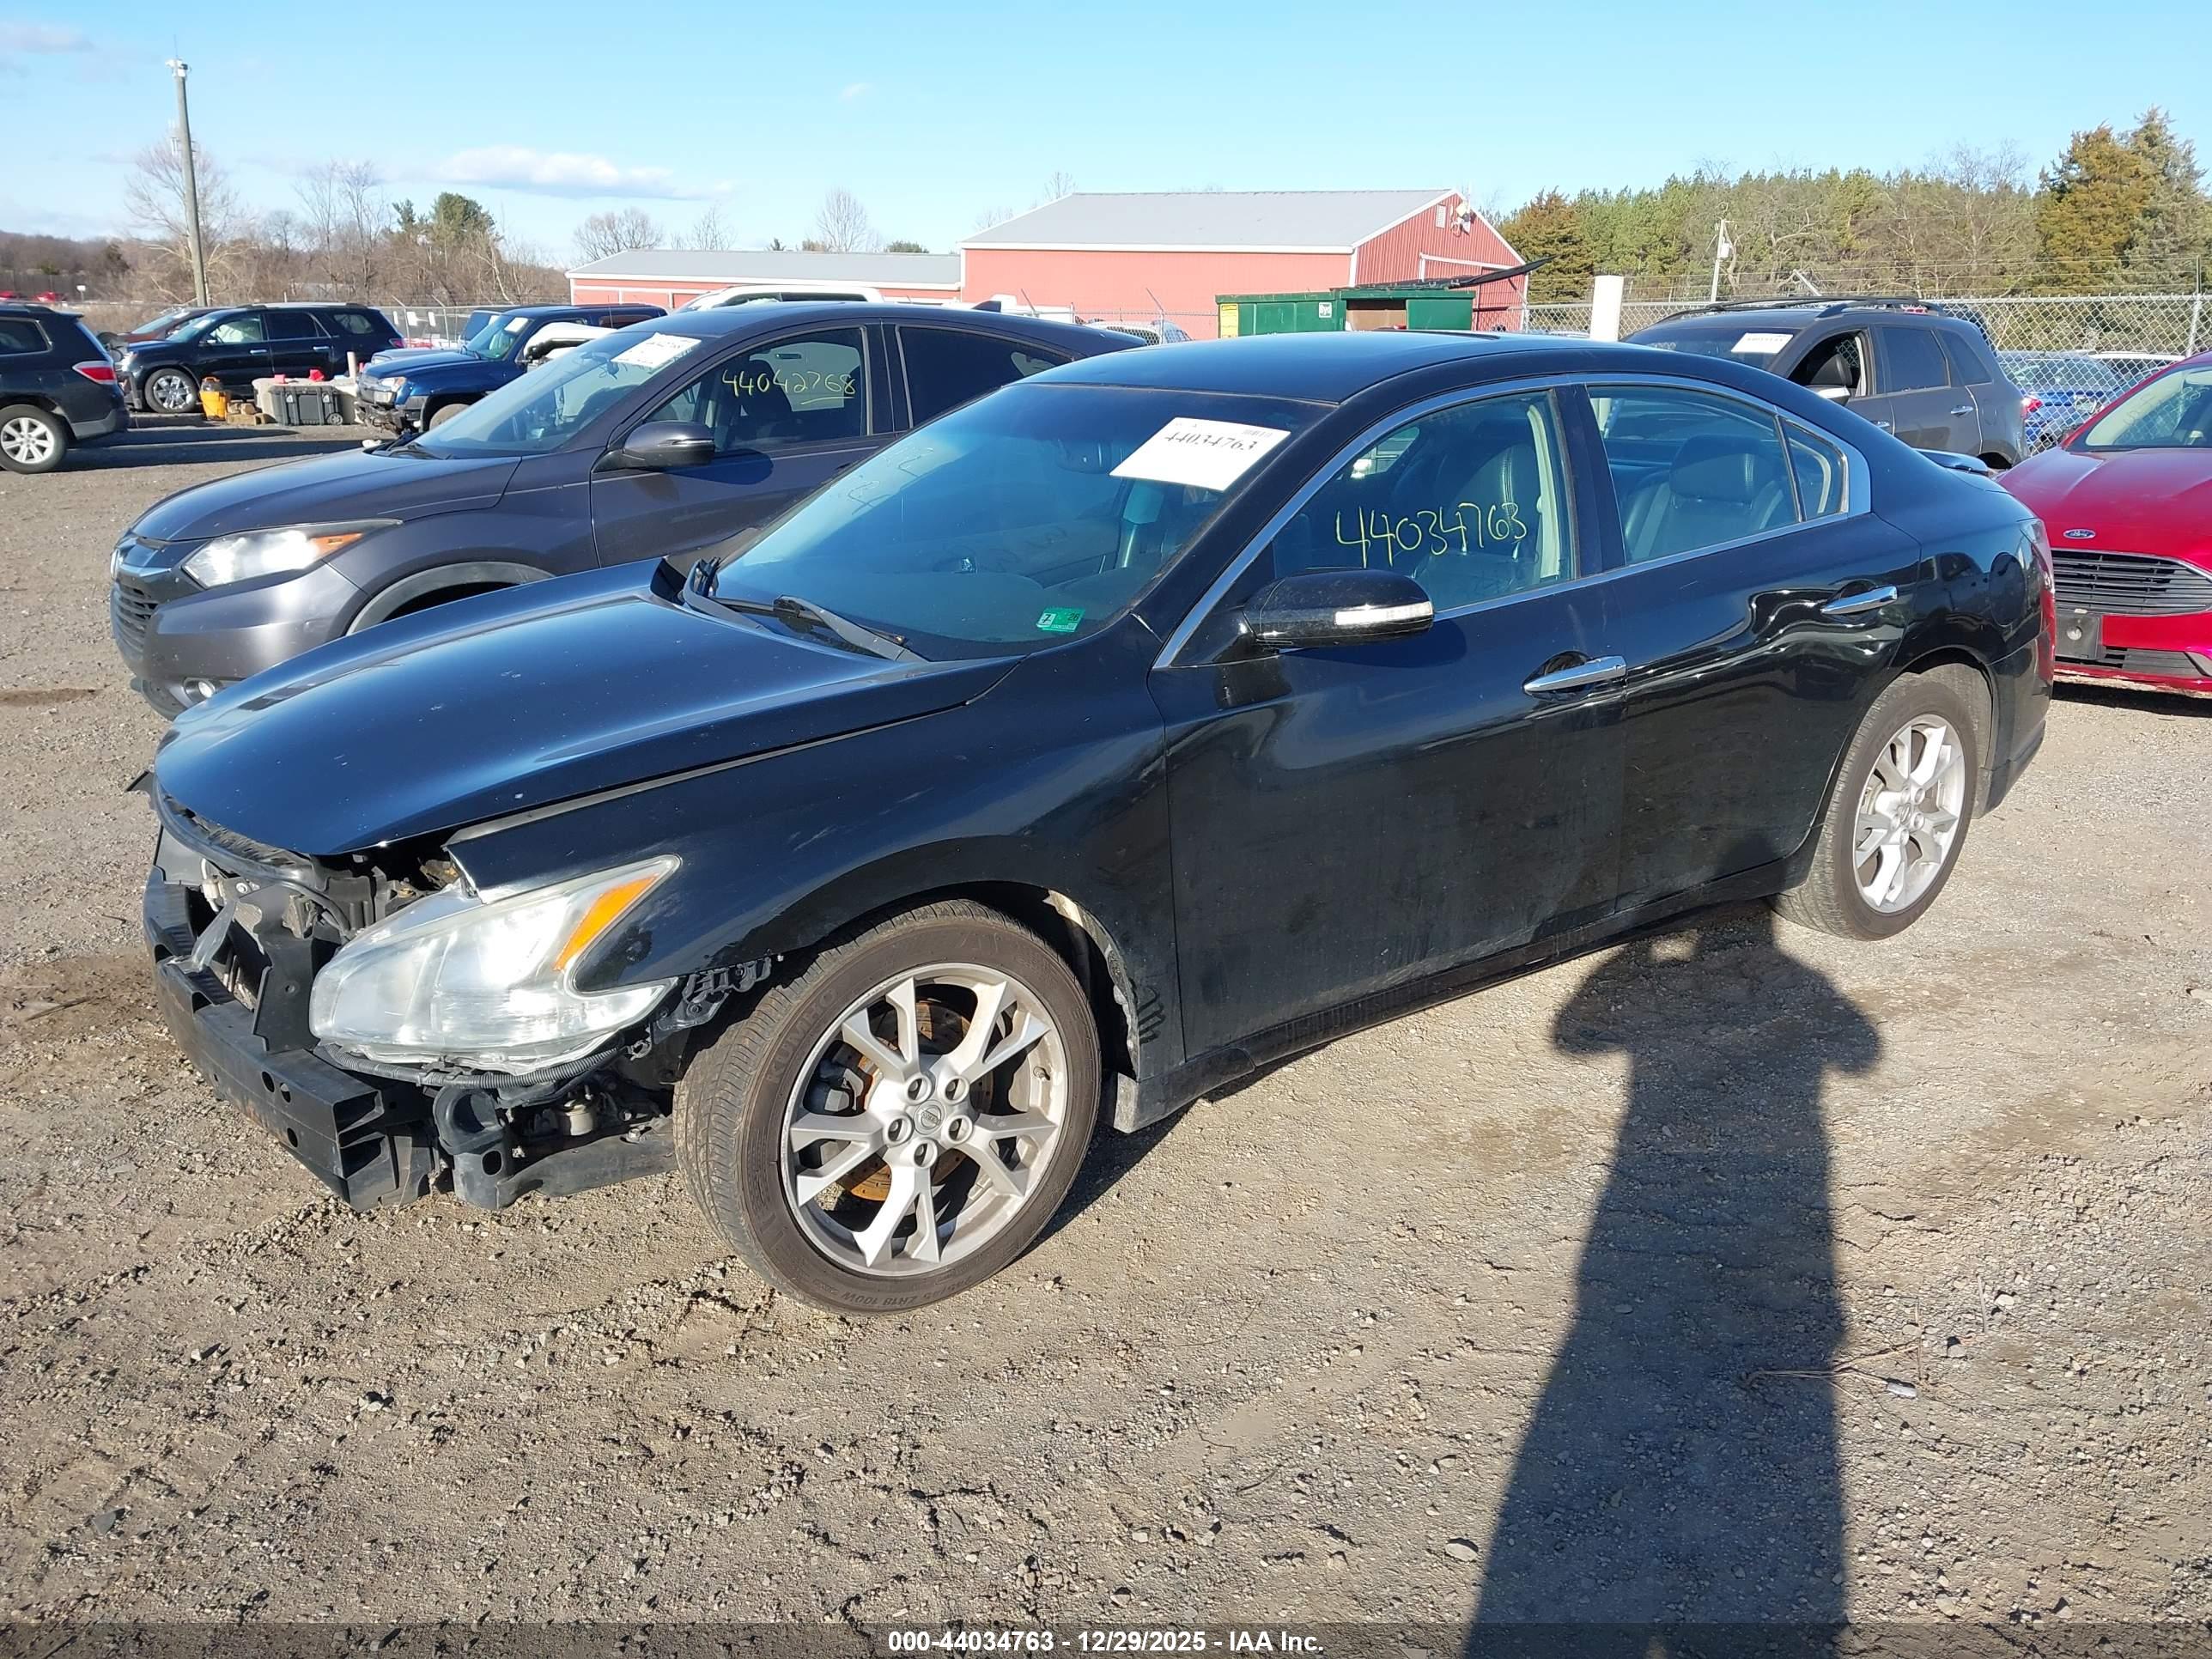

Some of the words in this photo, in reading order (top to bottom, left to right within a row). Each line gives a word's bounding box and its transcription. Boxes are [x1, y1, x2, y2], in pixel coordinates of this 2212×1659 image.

[721, 369, 857, 398] 44042768
[1164, 431, 1258, 452] 44034763
[1335, 501, 1528, 568] 44034763
[1042, 613, 1052, 623] 7
